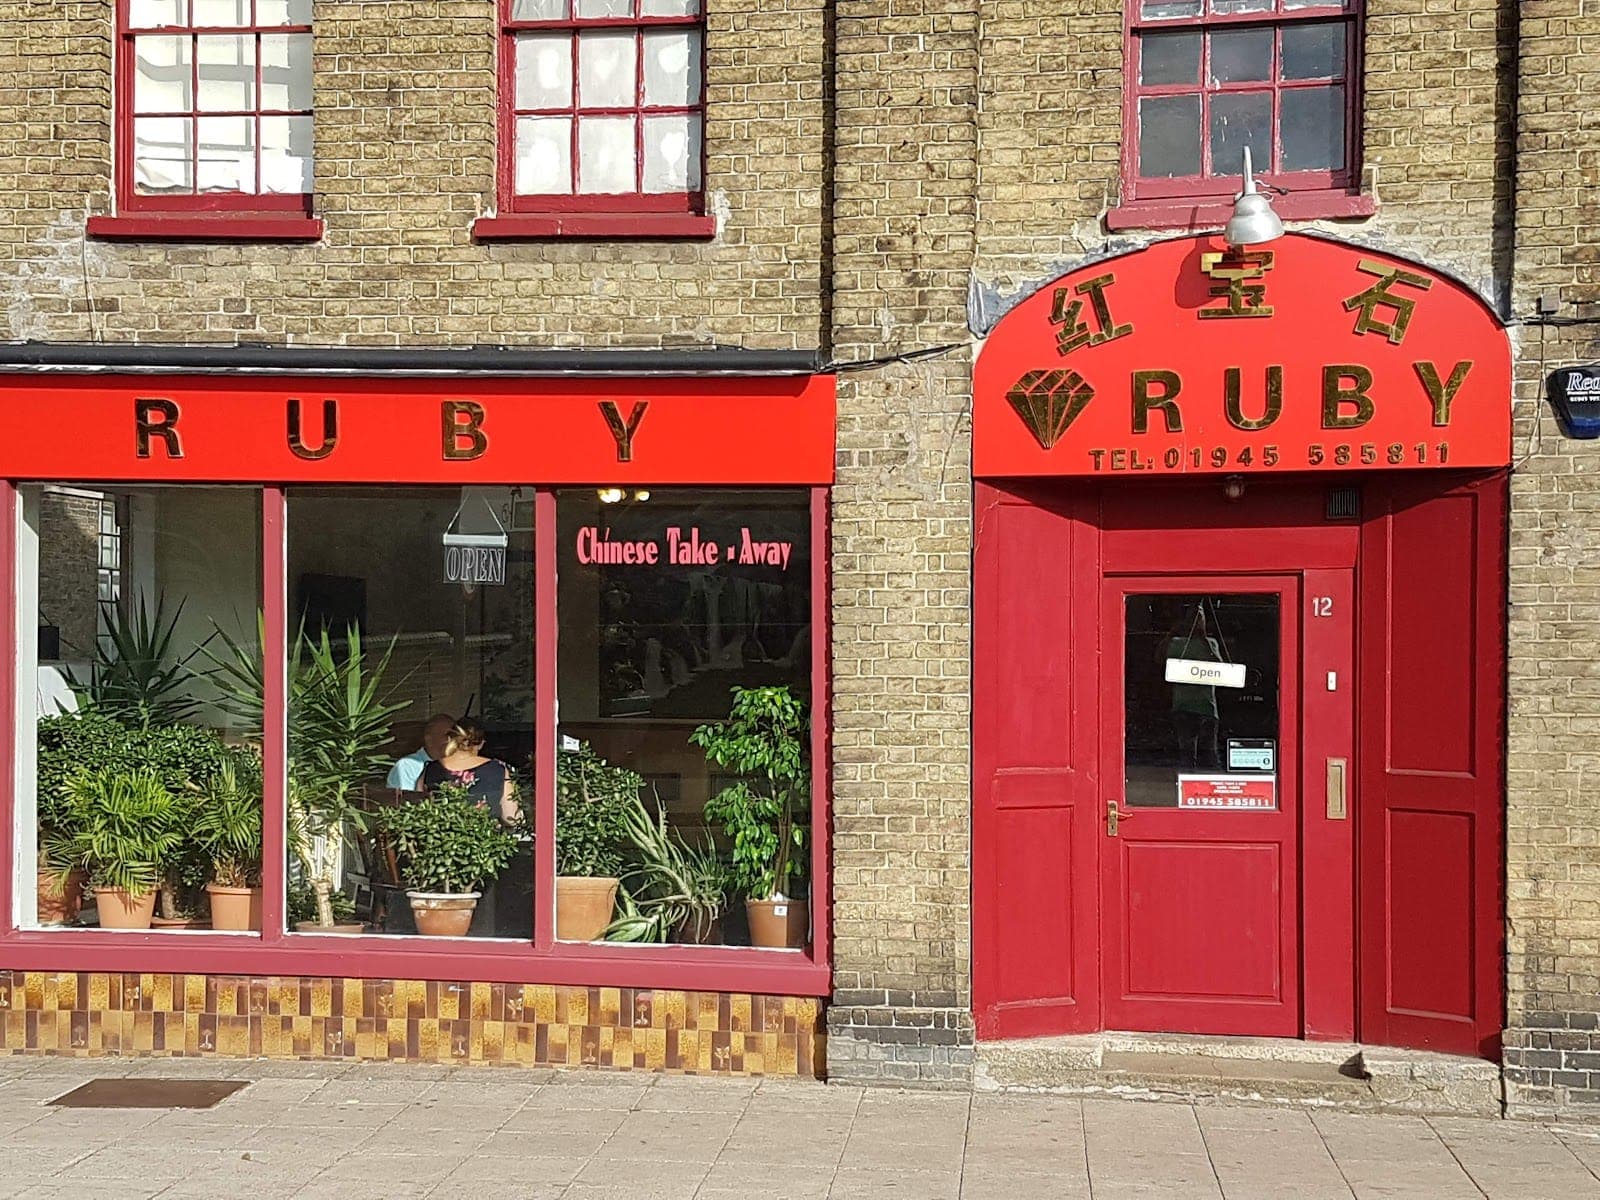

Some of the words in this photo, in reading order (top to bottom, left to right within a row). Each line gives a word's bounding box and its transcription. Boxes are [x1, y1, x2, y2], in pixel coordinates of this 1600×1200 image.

[1131, 360, 1473, 434] RUBY
[135, 397, 649, 462] RUBY
[1307, 441, 1449, 466] 585811
[576, 526, 659, 565] Chinese
[666, 526, 719, 565] Take
[446, 547, 503, 582] OPEN
[1312, 597, 1333, 617] 12
[1190, 666, 1221, 678] Open
[1187, 797, 1224, 806] 01945
[1227, 797, 1270, 806] 585811
